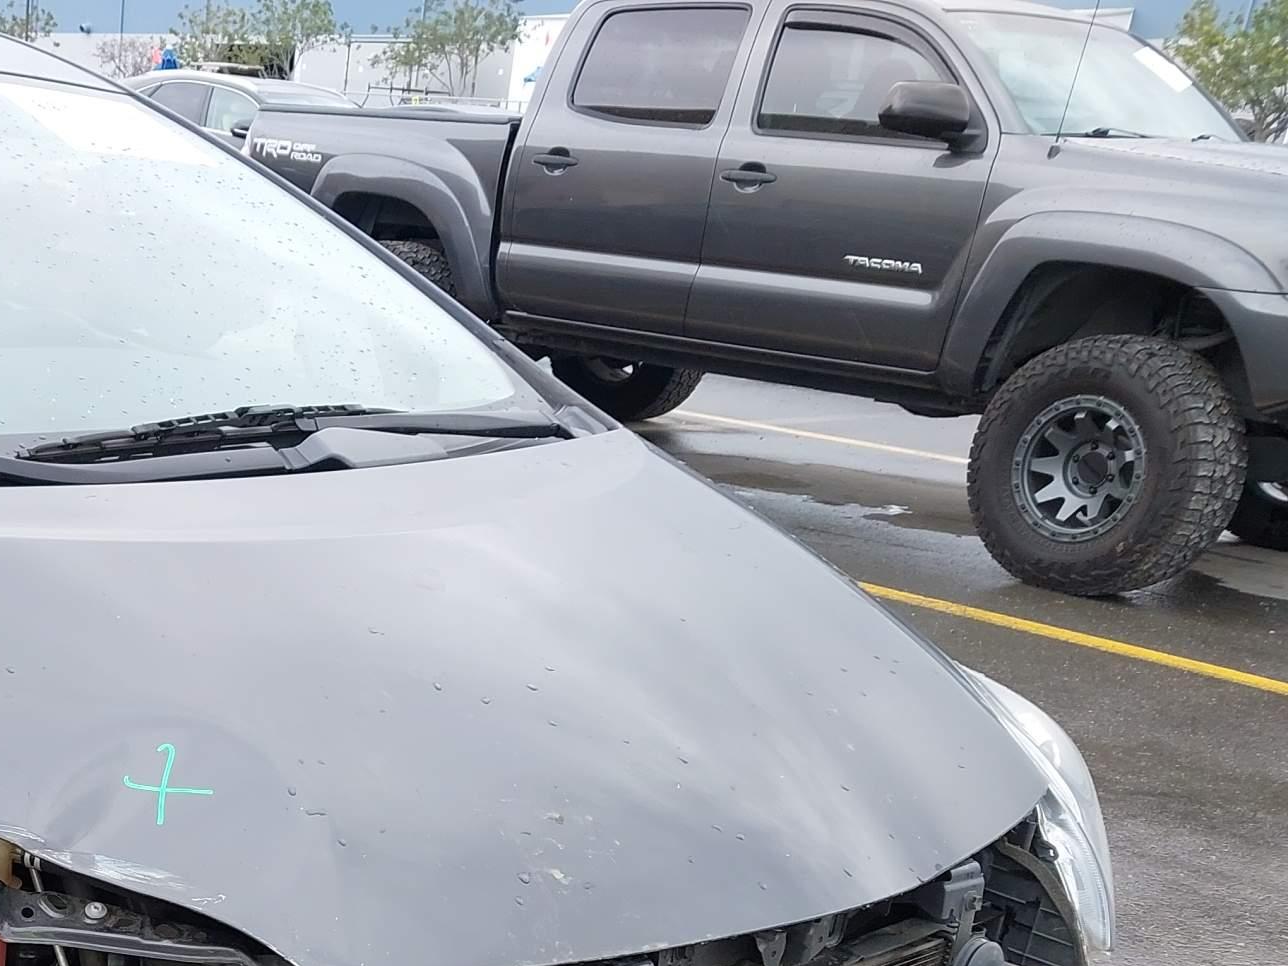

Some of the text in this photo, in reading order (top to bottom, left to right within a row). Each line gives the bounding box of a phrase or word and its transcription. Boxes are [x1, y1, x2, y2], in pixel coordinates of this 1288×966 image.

[254, 138, 291, 158] TRD
[291, 152, 321, 161] ROAD
[843, 255, 923, 274] TACOMA
